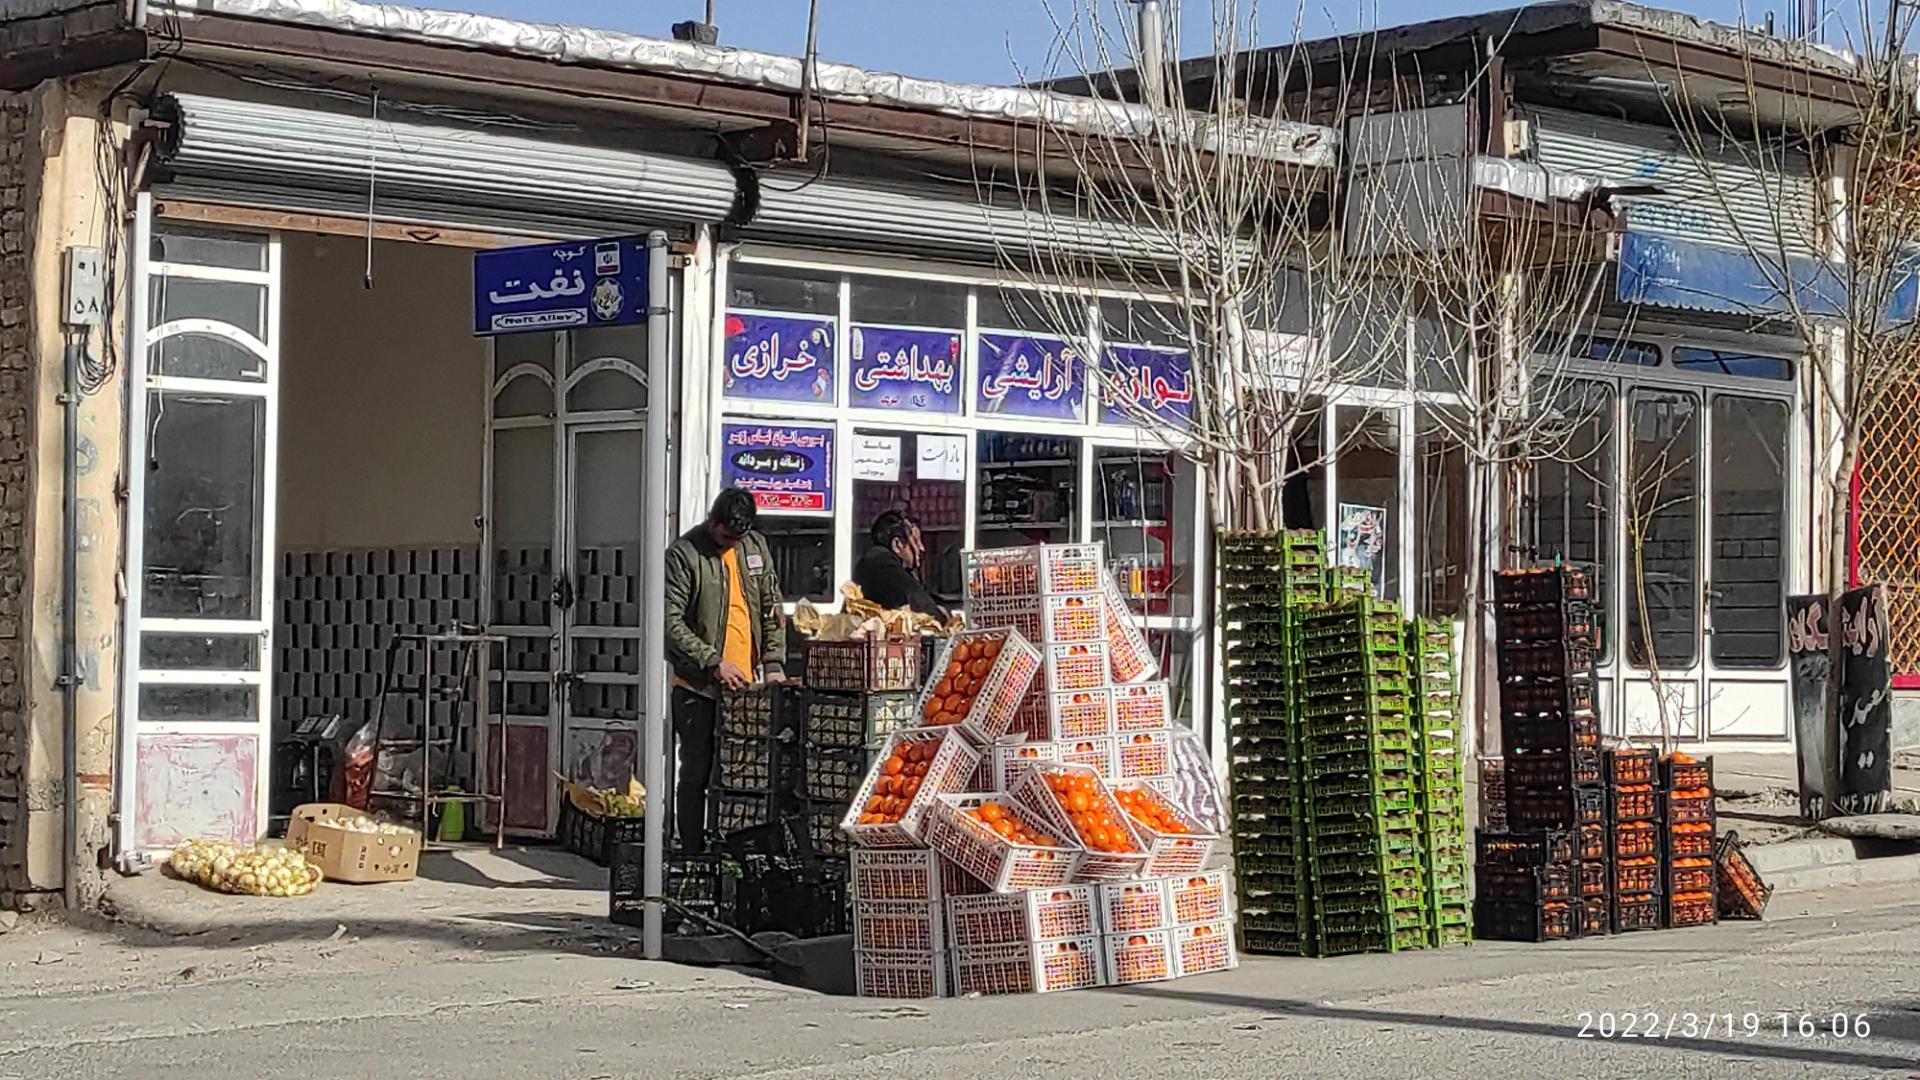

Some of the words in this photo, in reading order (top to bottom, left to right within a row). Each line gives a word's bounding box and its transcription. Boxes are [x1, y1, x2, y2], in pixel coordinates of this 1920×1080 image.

[553, 246, 586, 262] کوچه
[489, 269, 585, 304] نفت
[732, 332, 818, 380] خرازی
[855, 345, 955, 393] بهداشتی
[982, 348, 1077, 400] آرایشی
[738, 453, 772, 470] مردانه
[779, 453, 806, 472] زنانه
